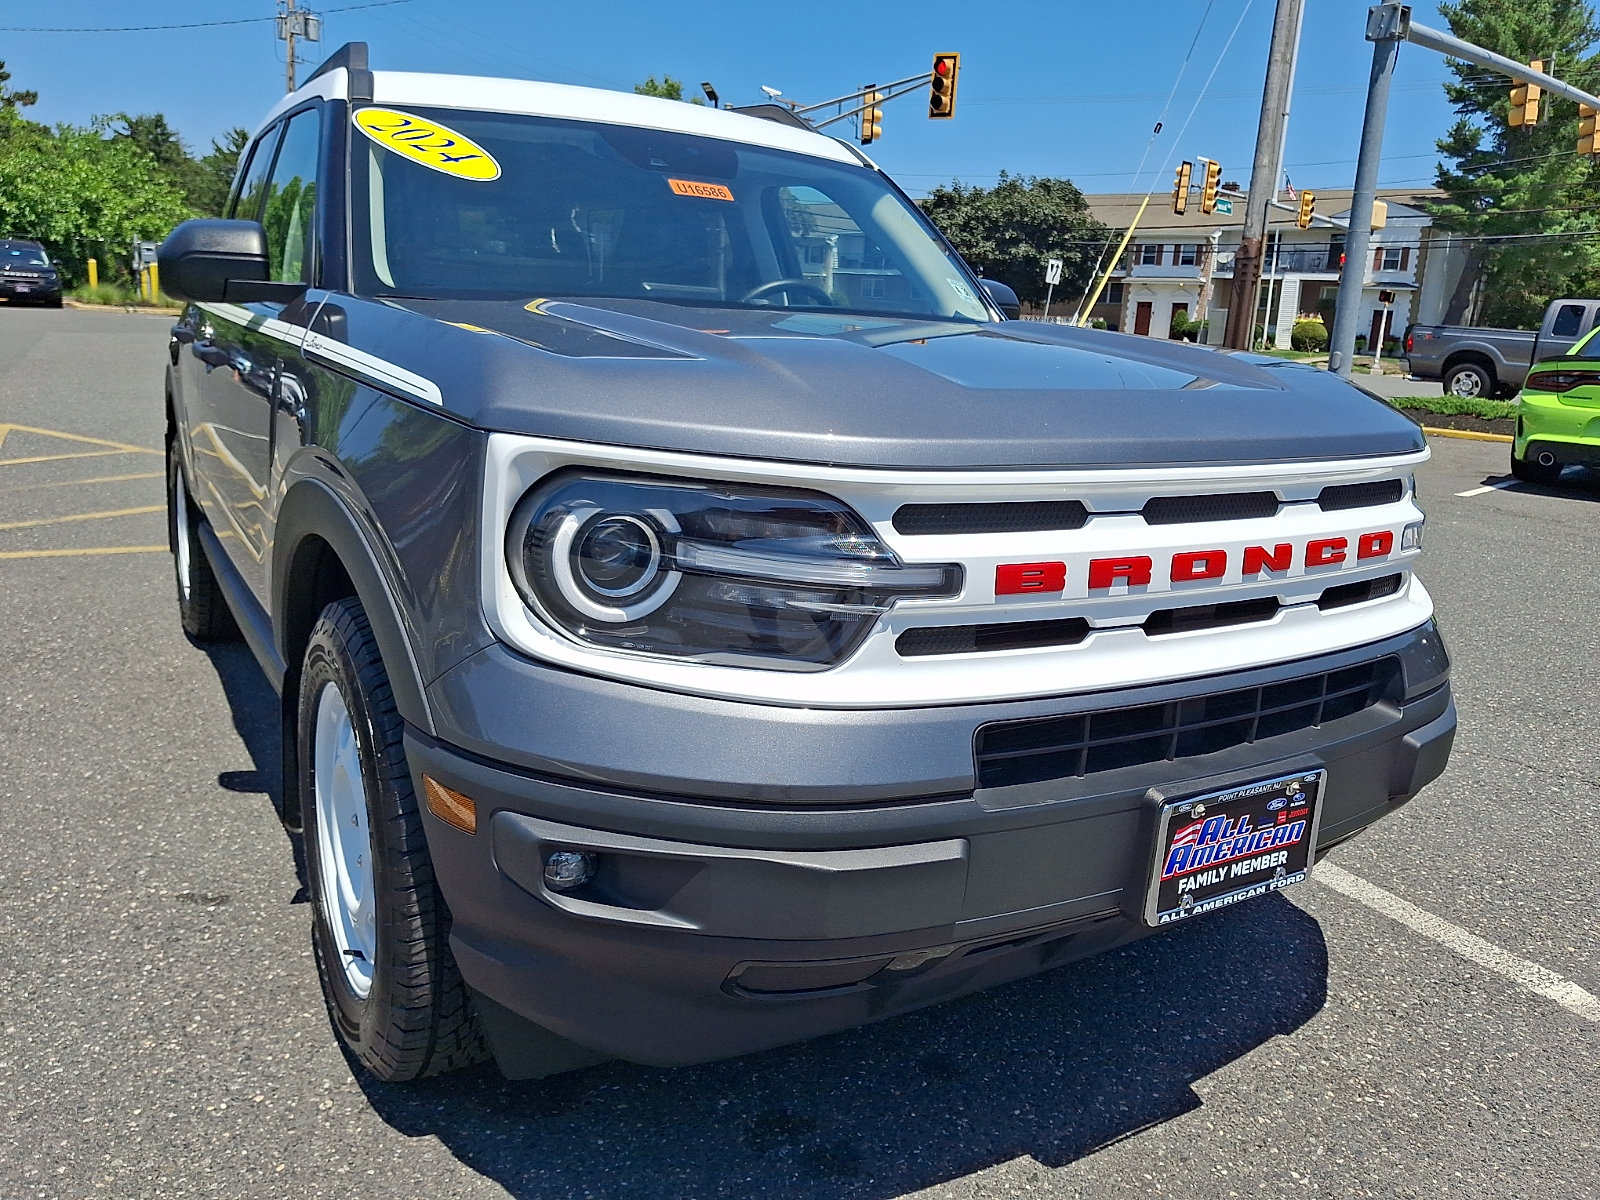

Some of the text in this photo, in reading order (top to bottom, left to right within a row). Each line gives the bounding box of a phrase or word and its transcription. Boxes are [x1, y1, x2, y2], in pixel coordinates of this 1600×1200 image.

[366, 119, 483, 163] 2024
[676, 183, 727, 198] U16586
[994, 530, 1394, 596] BRONCO
[1218, 791, 1239, 803] POINT
[1177, 851, 1288, 895] FAMILY MEMBER
[1160, 873, 1306, 924] ALL AMERICAN FORD
